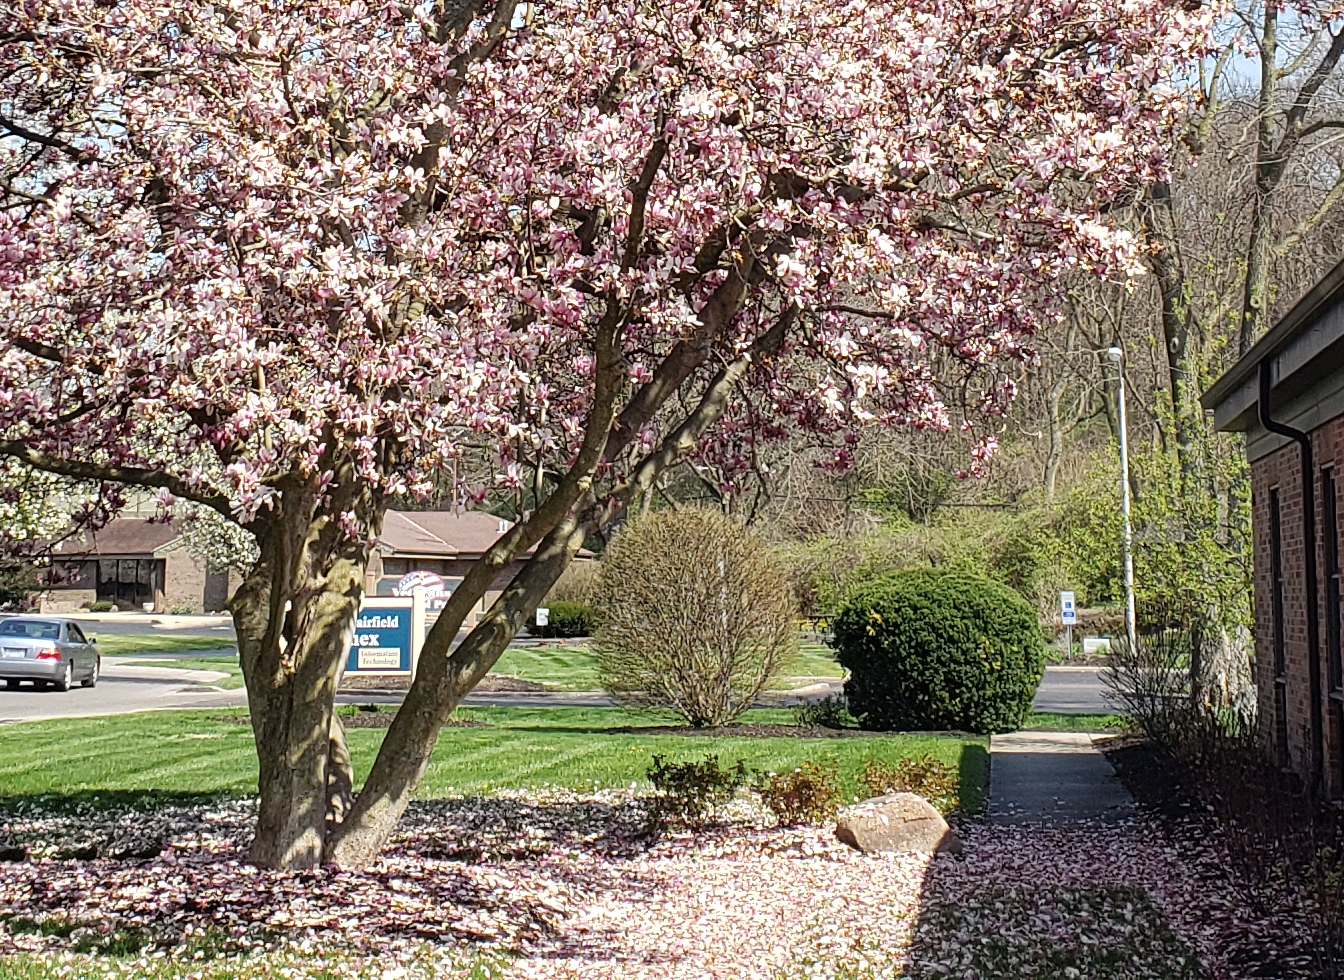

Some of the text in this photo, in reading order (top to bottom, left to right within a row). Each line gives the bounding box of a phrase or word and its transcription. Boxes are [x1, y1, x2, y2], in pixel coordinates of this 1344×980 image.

[356, 615, 399, 628] airfield
[351, 634, 380, 647] nex
[361, 650, 399, 658] Information
[362, 657, 398, 666] Technology
